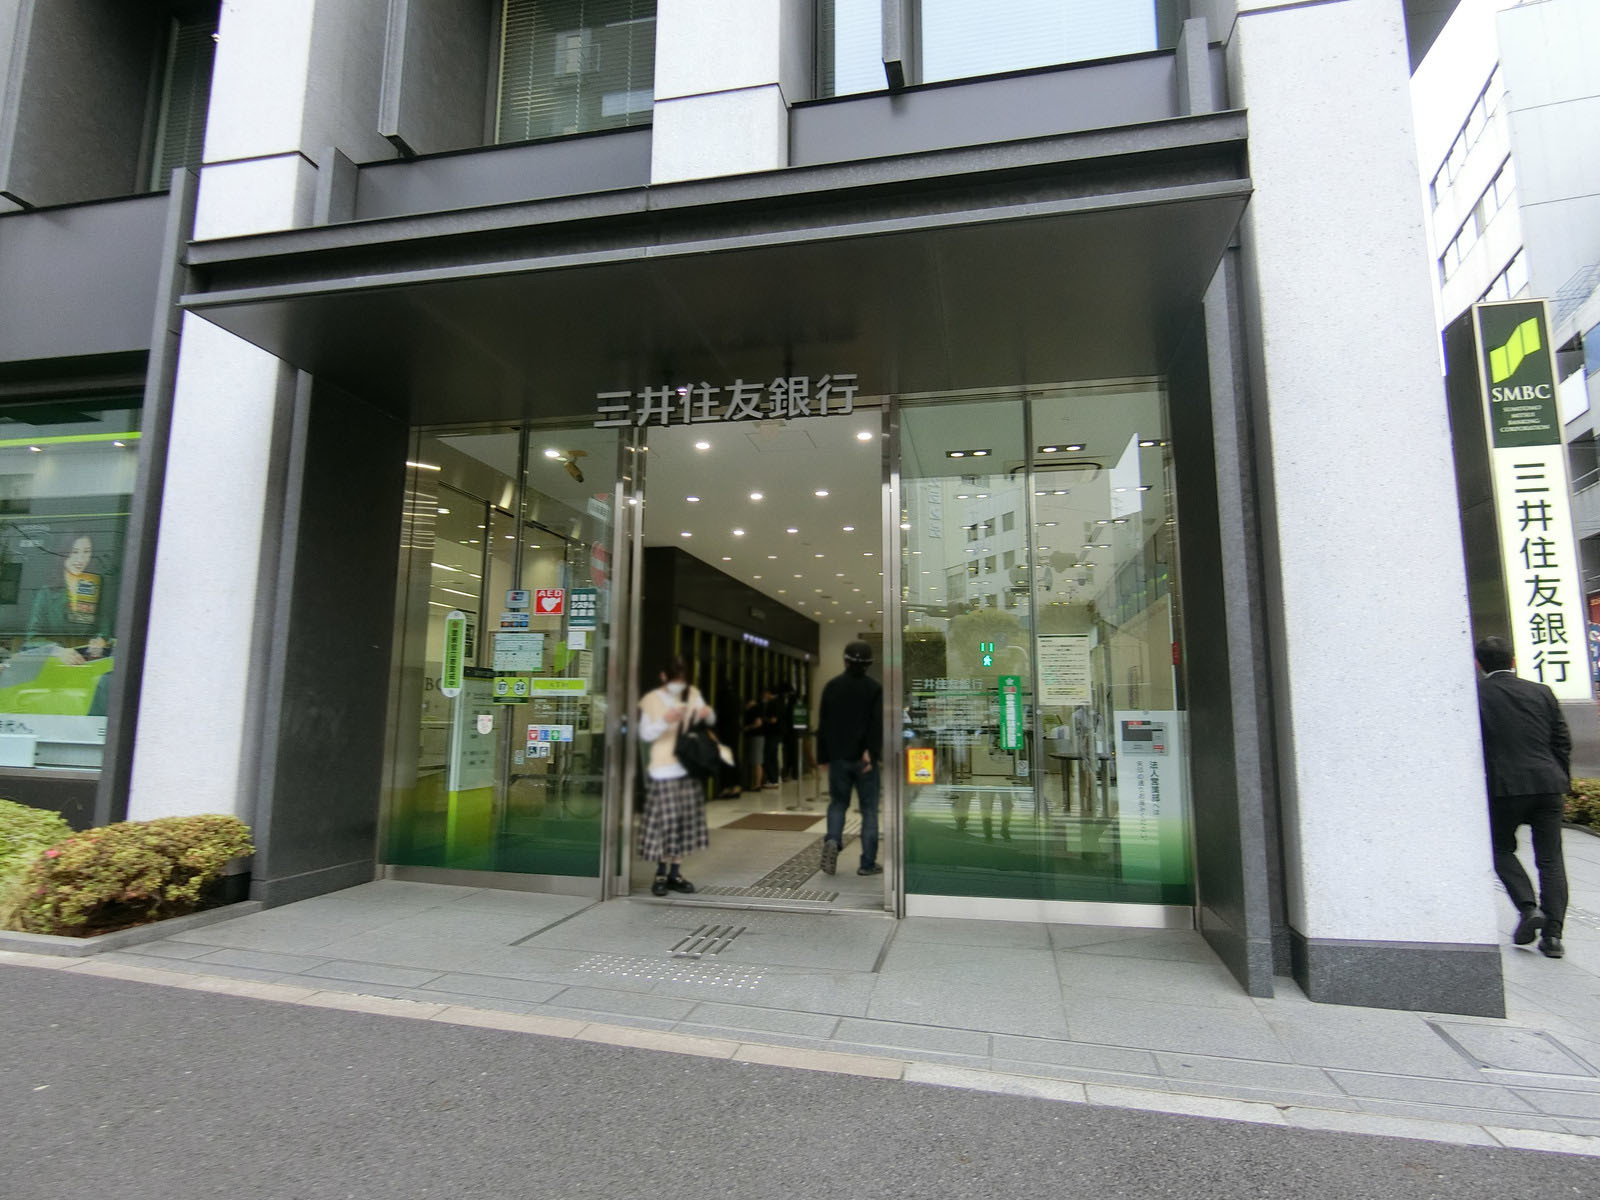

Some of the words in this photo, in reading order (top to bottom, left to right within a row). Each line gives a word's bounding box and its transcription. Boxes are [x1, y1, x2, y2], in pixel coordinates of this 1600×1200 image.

[593, 373, 859, 427] 三井住友銀行
[1491, 384, 1552, 403] SMBC
[1513, 462, 1571, 684] 三井住友銀行
[538, 589, 562, 597] AED
